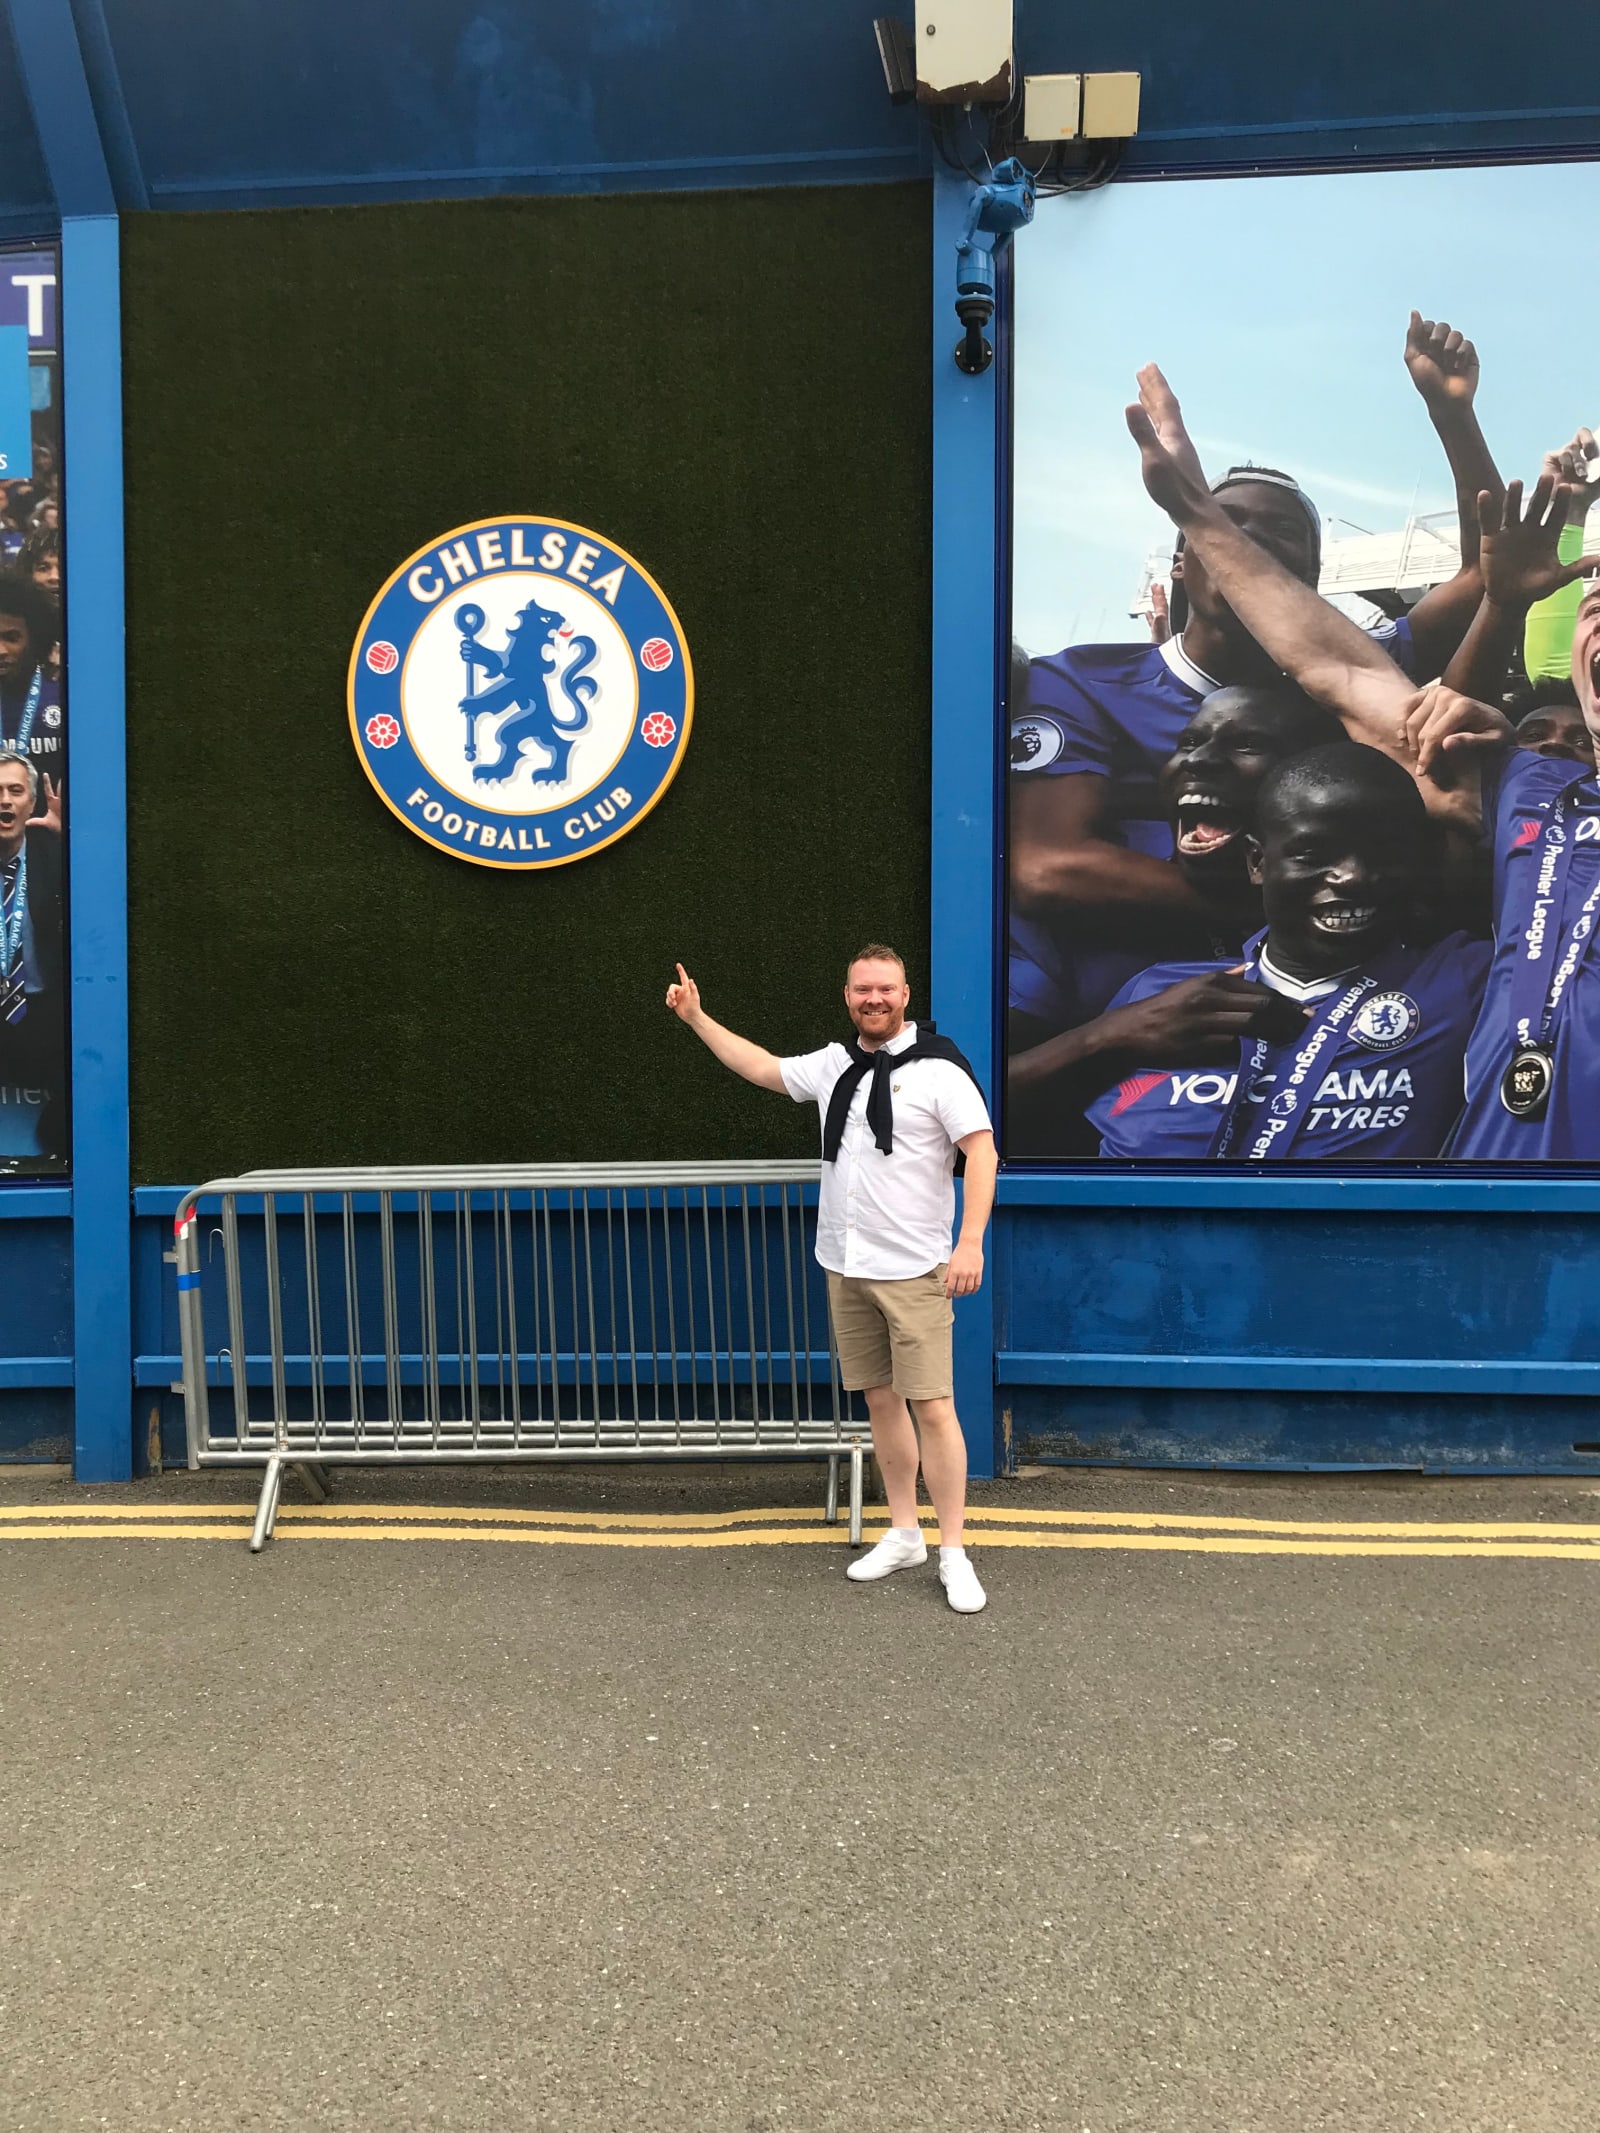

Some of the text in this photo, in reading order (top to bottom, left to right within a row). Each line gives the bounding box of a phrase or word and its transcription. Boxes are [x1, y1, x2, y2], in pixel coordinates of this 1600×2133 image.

[408, 529, 627, 606] CHELSEA
[406, 786, 633, 850] FOOTBALL CLUB
[1525, 844, 1564, 960] Premier League
[1327, 976, 1378, 1026] Premier
[1546, 942, 1580, 1008] League
[1289, 1025, 1339, 1084] League
[1306, 1105, 1410, 1131] TYRES
